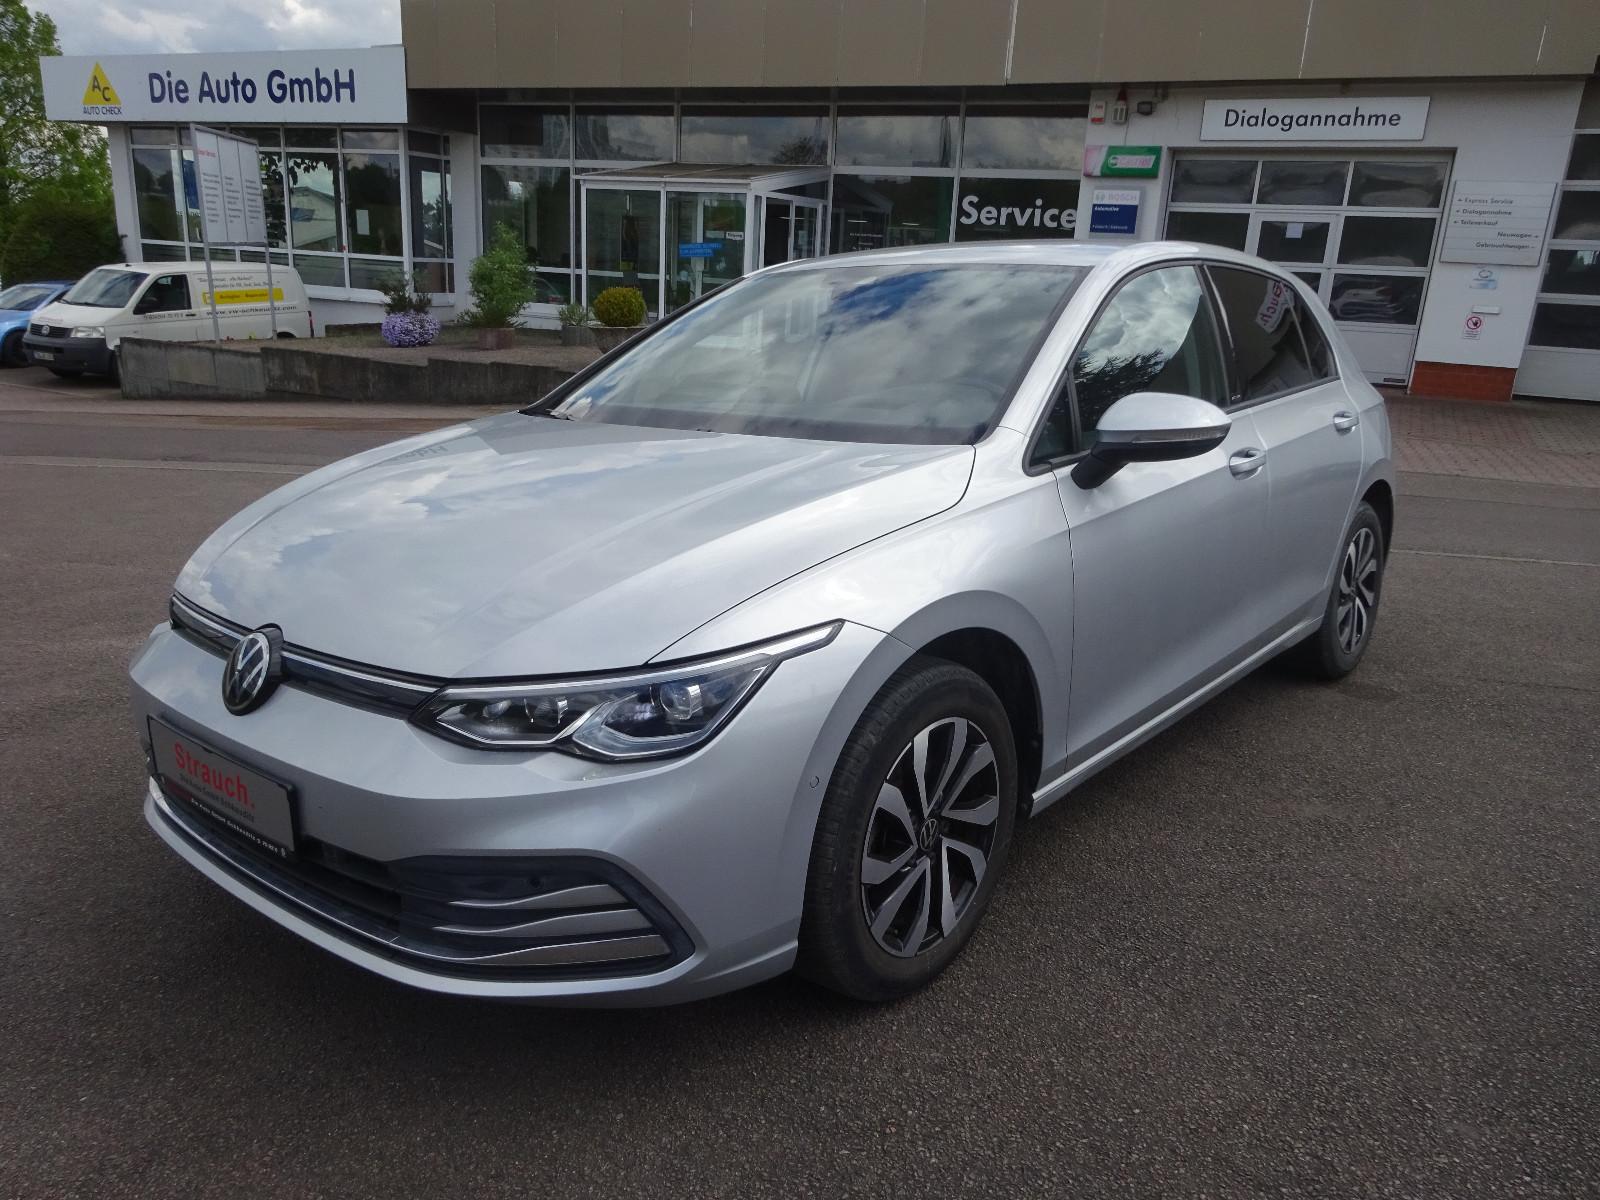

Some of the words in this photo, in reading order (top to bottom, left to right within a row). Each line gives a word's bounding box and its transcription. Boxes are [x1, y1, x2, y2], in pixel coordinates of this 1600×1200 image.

[149, 70, 189, 103] Die
[199, 71, 257, 103] Auto
[267, 67, 355, 103] GmbH
[83, 106, 100, 115] AUTO
[101, 106, 122, 115] CHECK
[1224, 106, 1402, 132] Dialogannahme
[959, 195, 1077, 228] Service
[1462, 208, 1512, 216] Dialogannahme
[173, 741, 256, 811] Strauch.
